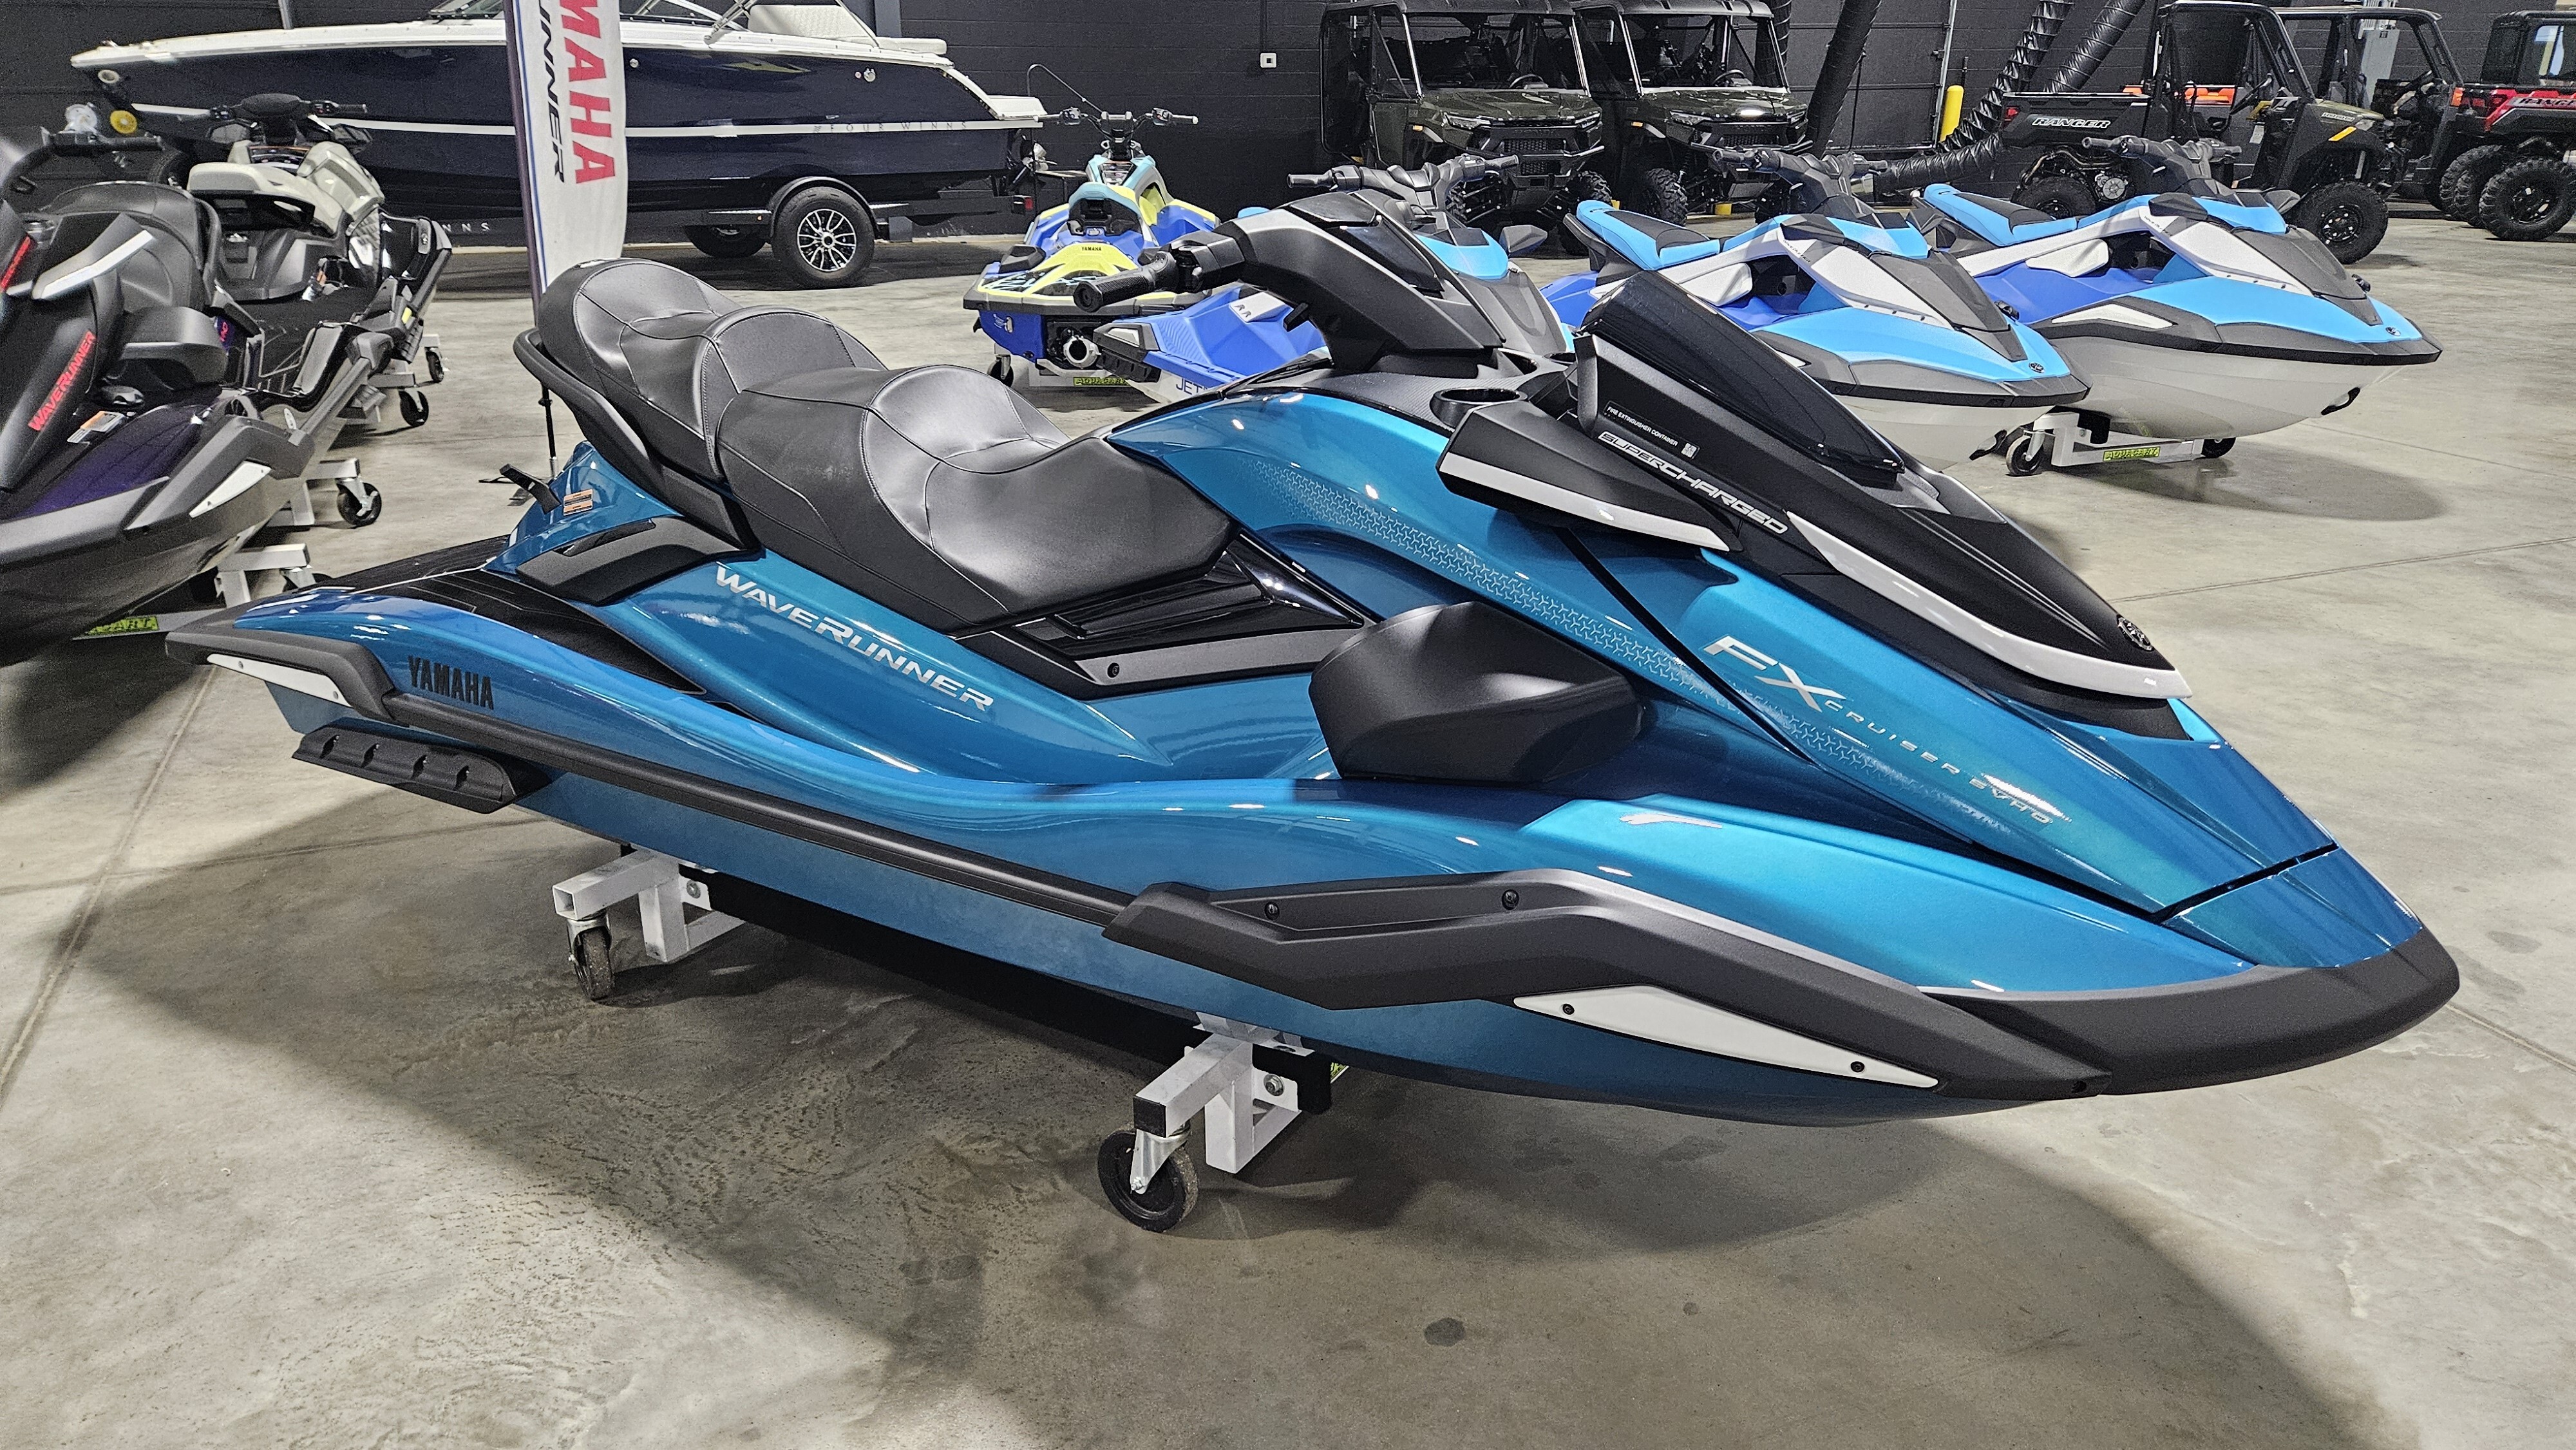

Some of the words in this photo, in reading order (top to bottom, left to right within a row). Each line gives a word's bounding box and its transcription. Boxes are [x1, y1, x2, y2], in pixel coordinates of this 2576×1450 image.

[830, 123, 884, 133] FOUR
[901, 121, 967, 131] WINNS
[2032, 117, 2111, 129] RANGER
[1176, 378, 1208, 395] JET
[1607, 406, 1618, 416] FIRE
[1617, 411, 1652, 433] EXTINGUISHER
[1651, 428, 1678, 447] CONTAINER
[1598, 431, 1788, 534] SUPERCHARGED
[715, 565, 995, 711] WAVERUNNER
[407, 655, 494, 710] YAMAHA
[1703, 635, 1847, 713] FX
[1824, 699, 1960, 775] CRUISER
[1969, 776, 2054, 824] SVHO
